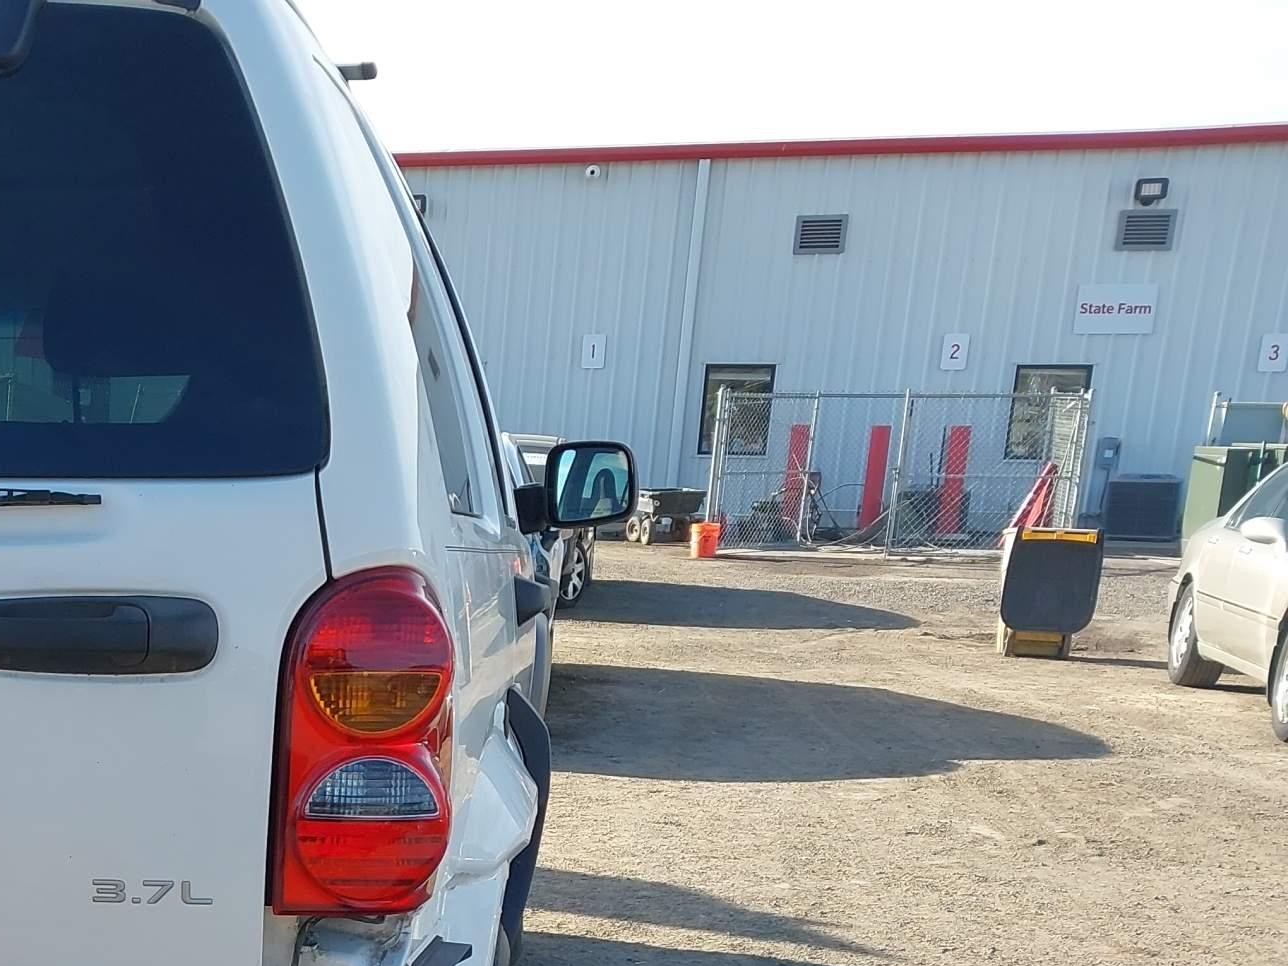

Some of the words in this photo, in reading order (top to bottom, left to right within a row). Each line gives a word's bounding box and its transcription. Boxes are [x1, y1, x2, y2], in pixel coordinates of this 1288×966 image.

[1079, 302, 1114, 315] State
[1117, 302, 1152, 315] Farm
[591, 343, 596, 359] 1
[949, 343, 961, 360] 2
[1268, 344, 1280, 361] 3
[92, 879, 213, 905] 3.7L
